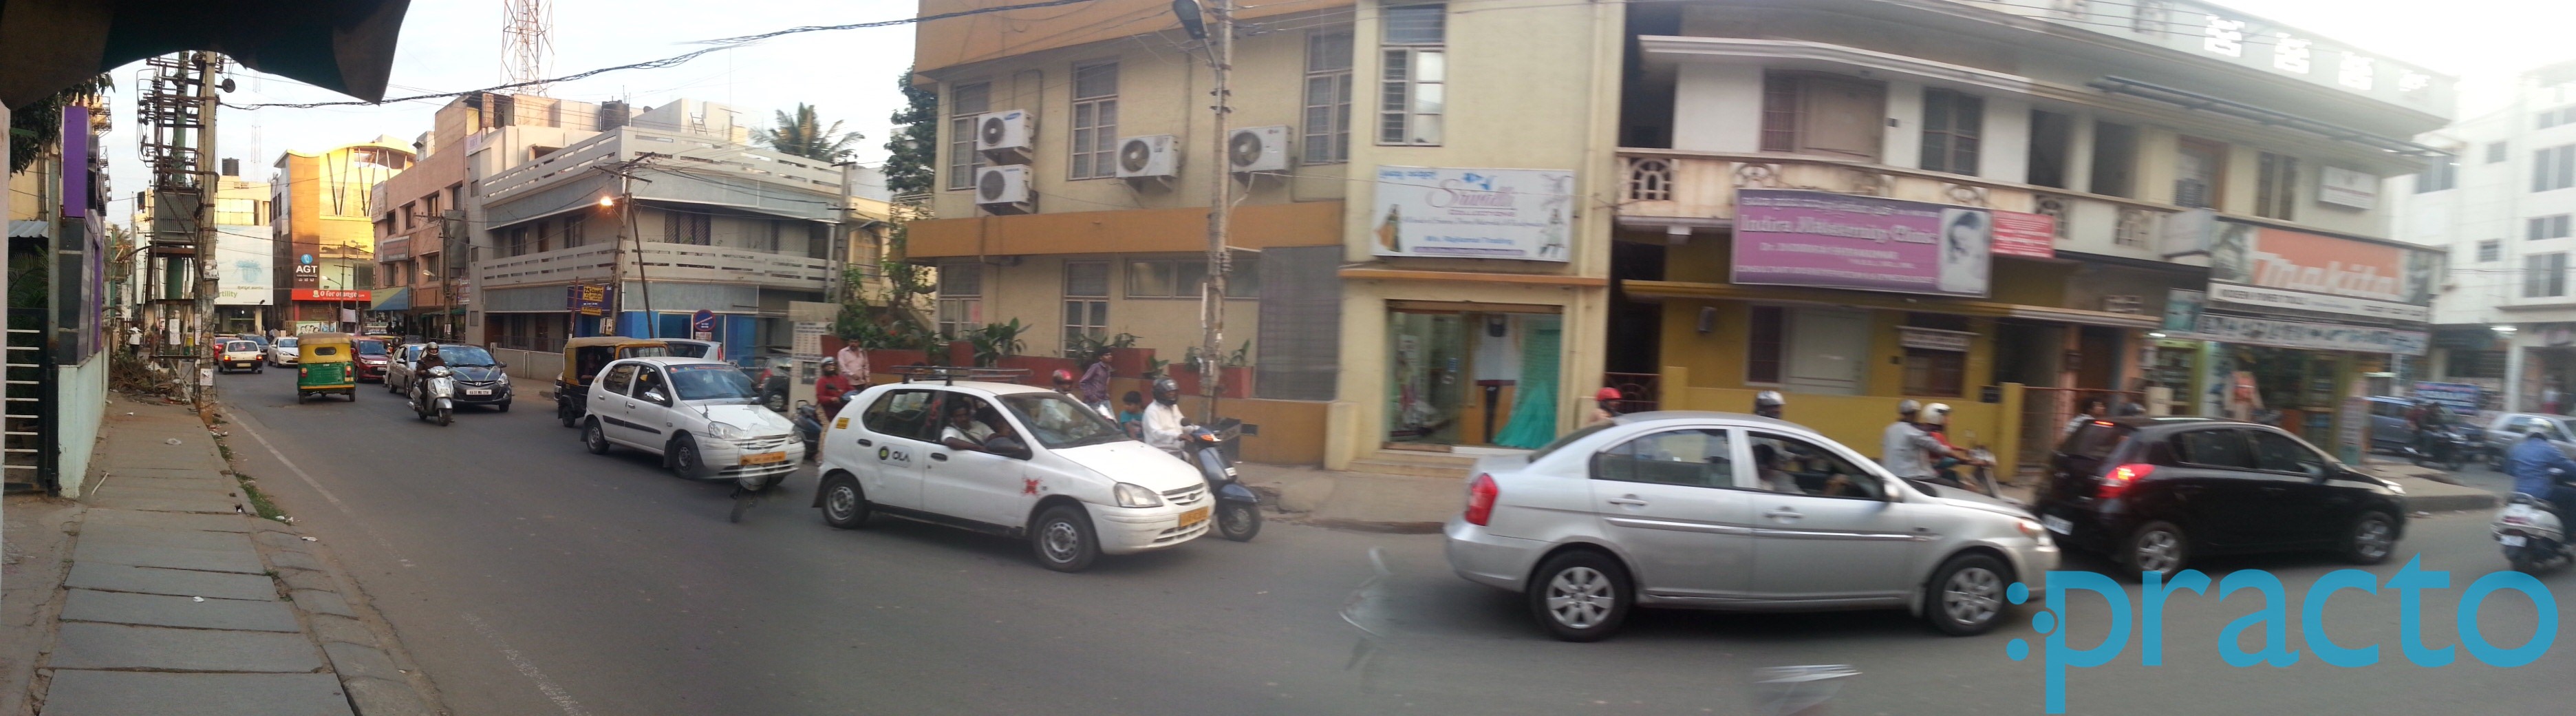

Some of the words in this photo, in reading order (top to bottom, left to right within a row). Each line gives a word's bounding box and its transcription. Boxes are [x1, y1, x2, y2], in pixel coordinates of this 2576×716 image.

[1740, 215, 1792, 233] Indira
[296, 265, 317, 273] AGT
[892, 450, 910, 463] OLA
